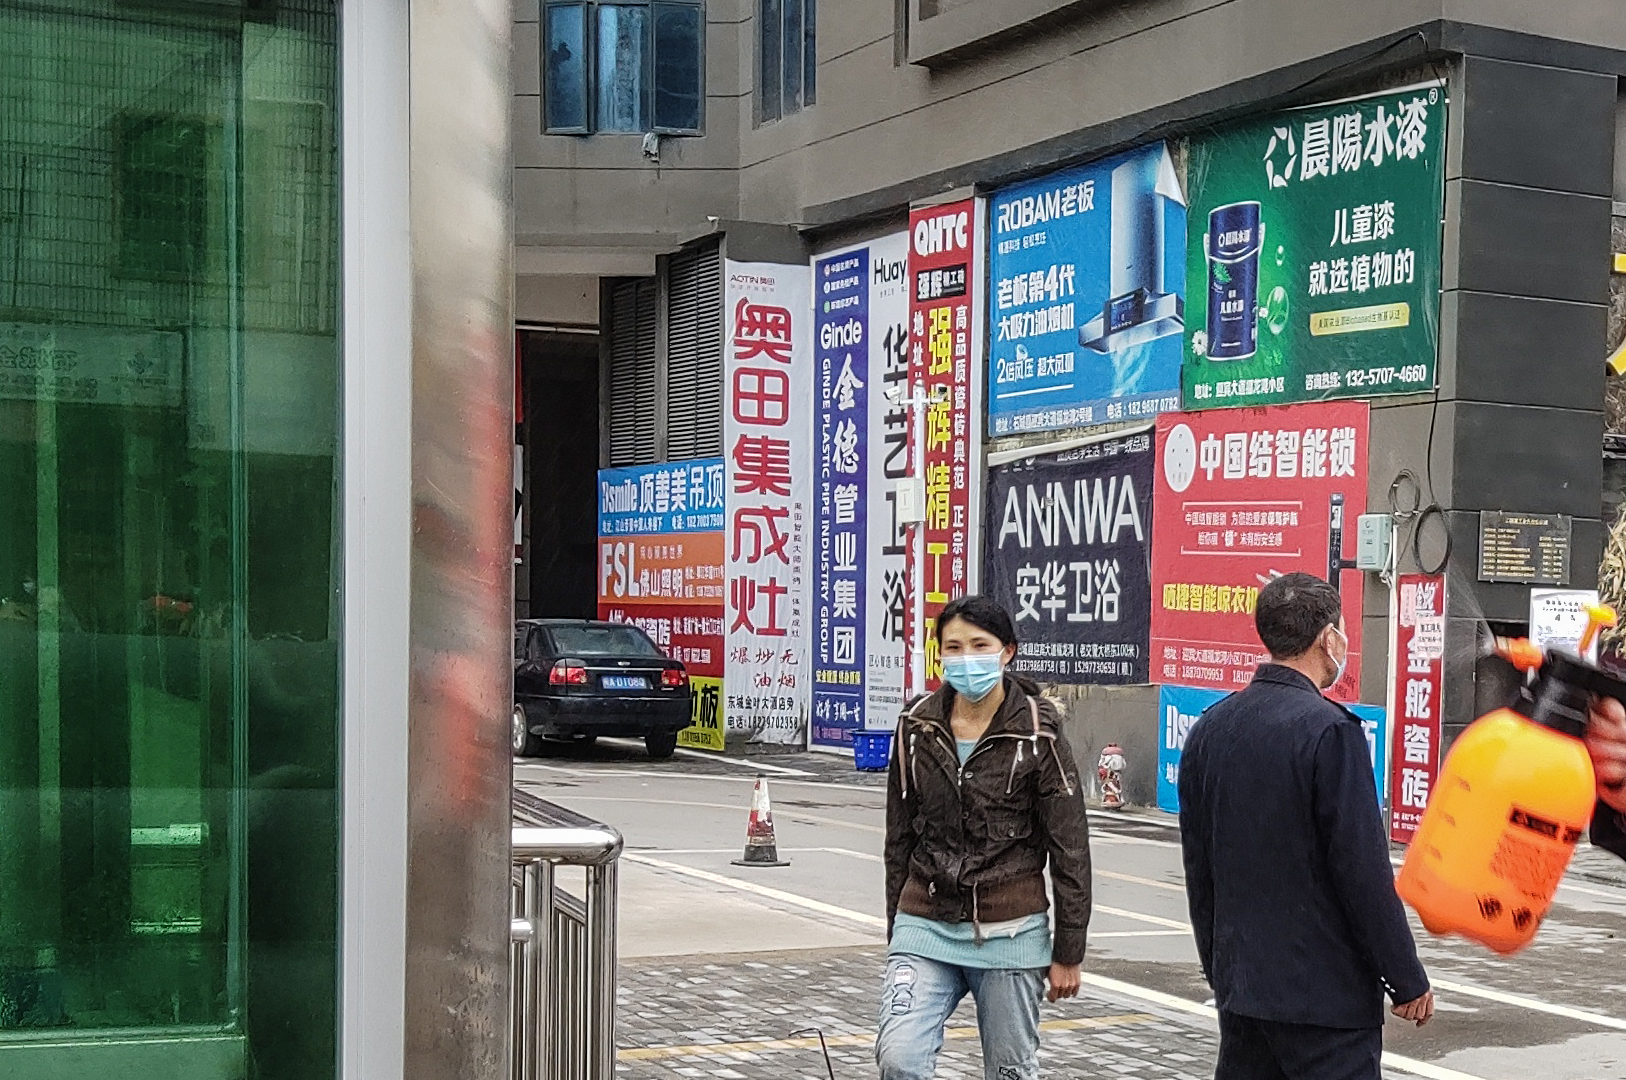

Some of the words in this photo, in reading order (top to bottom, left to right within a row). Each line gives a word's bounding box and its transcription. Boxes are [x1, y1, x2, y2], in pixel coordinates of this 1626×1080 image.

[1300, 97, 1428, 181] 晨陽水漆
[914, 211, 968, 257] QHTC
[1330, 200, 1395, 247] 儿童漆
[998, 265, 1075, 310] 老板第4代
[1308, 248, 1414, 297] 就选植物的
[821, 318, 862, 349] Ginde
[822, 358, 831, 409] GINDE
[731, 297, 792, 637] 奥田集成灶
[822, 413, 831, 478] PLASTIC
[1200, 427, 1356, 481] 中国结智能锁
[821, 482, 830, 516] PIPE
[832, 353, 864, 664] 金德管业集团
[998, 475, 1144, 549] ANNWA
[602, 542, 639, 598] FSL
[820, 520, 830, 602] INDUSTRY
[1015, 559, 1121, 622] 安华卫浴
[819, 605, 829, 664] GROUP
